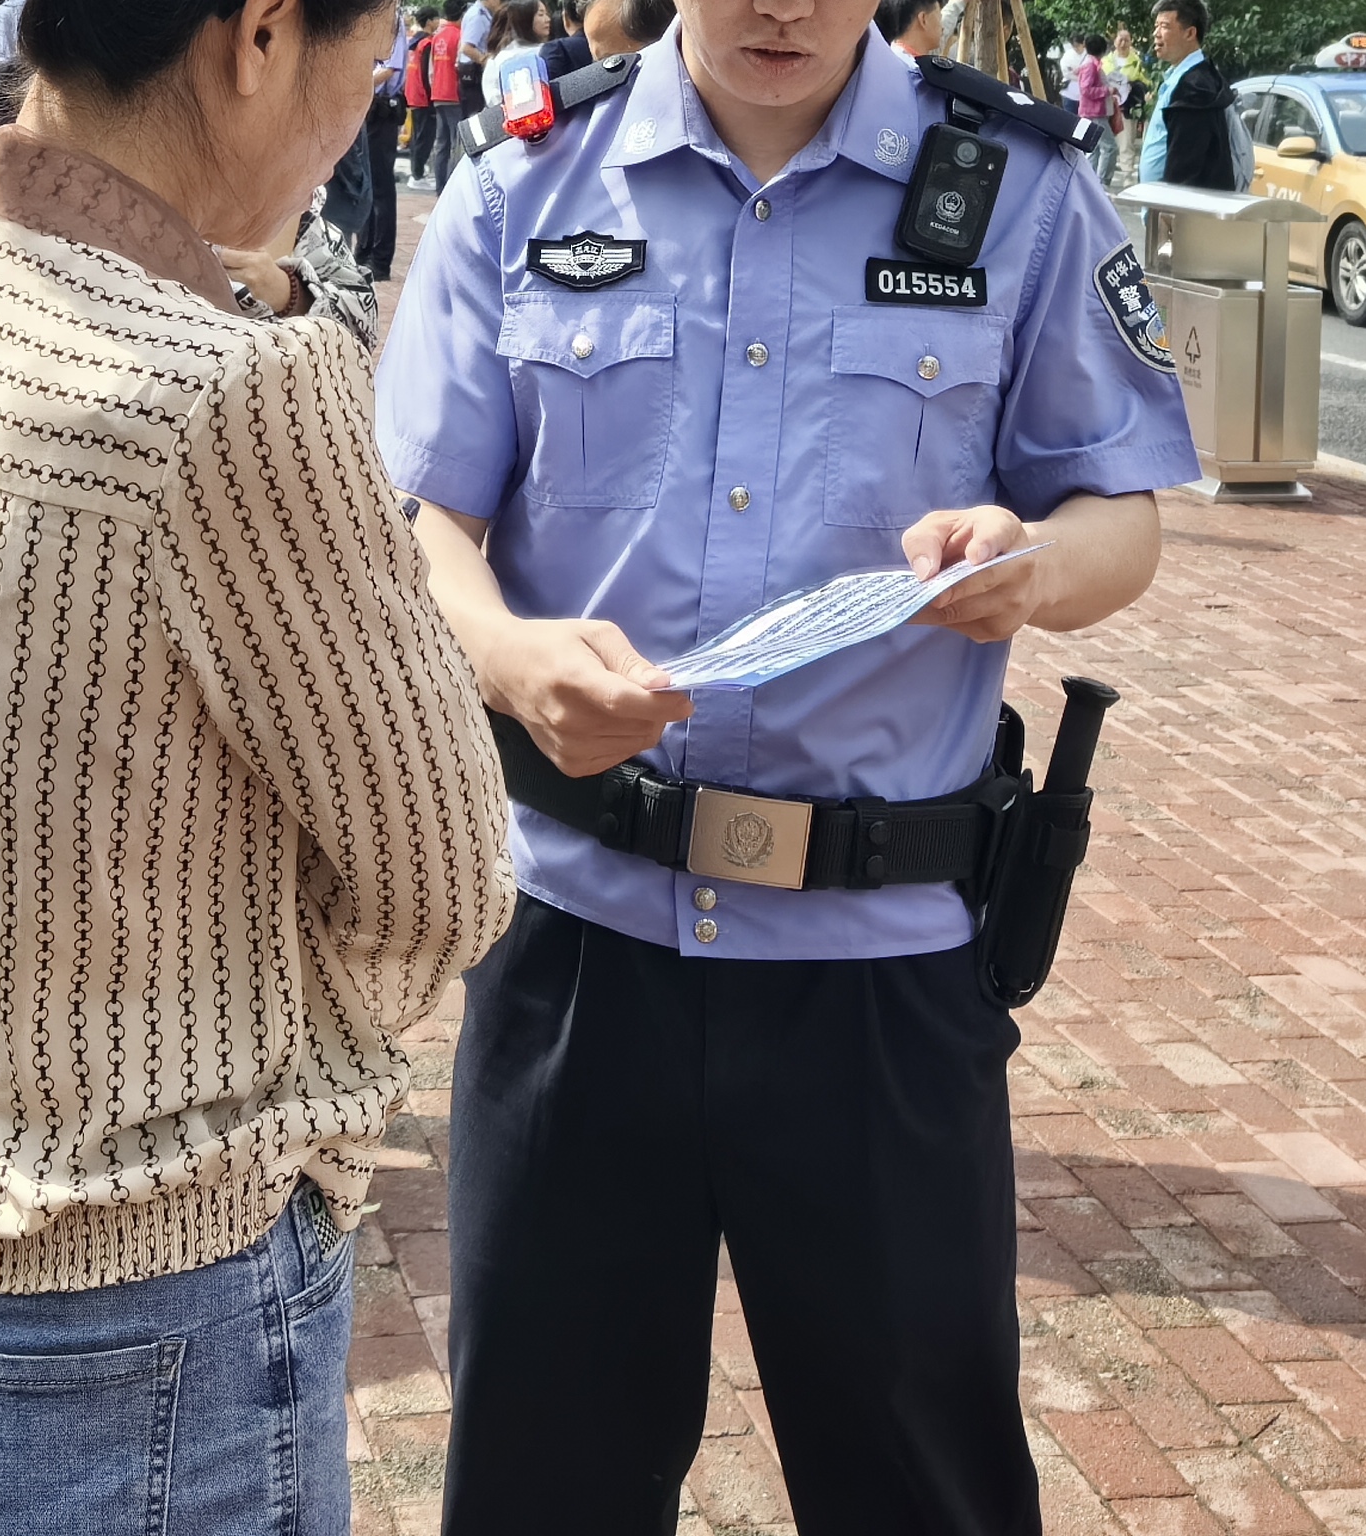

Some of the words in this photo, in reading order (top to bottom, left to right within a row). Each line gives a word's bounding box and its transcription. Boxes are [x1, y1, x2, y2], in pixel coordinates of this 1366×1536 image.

[929, 221, 960, 236] KEDACOM
[878, 270, 977, 298] 015554
[1118, 284, 1143, 312] 警
